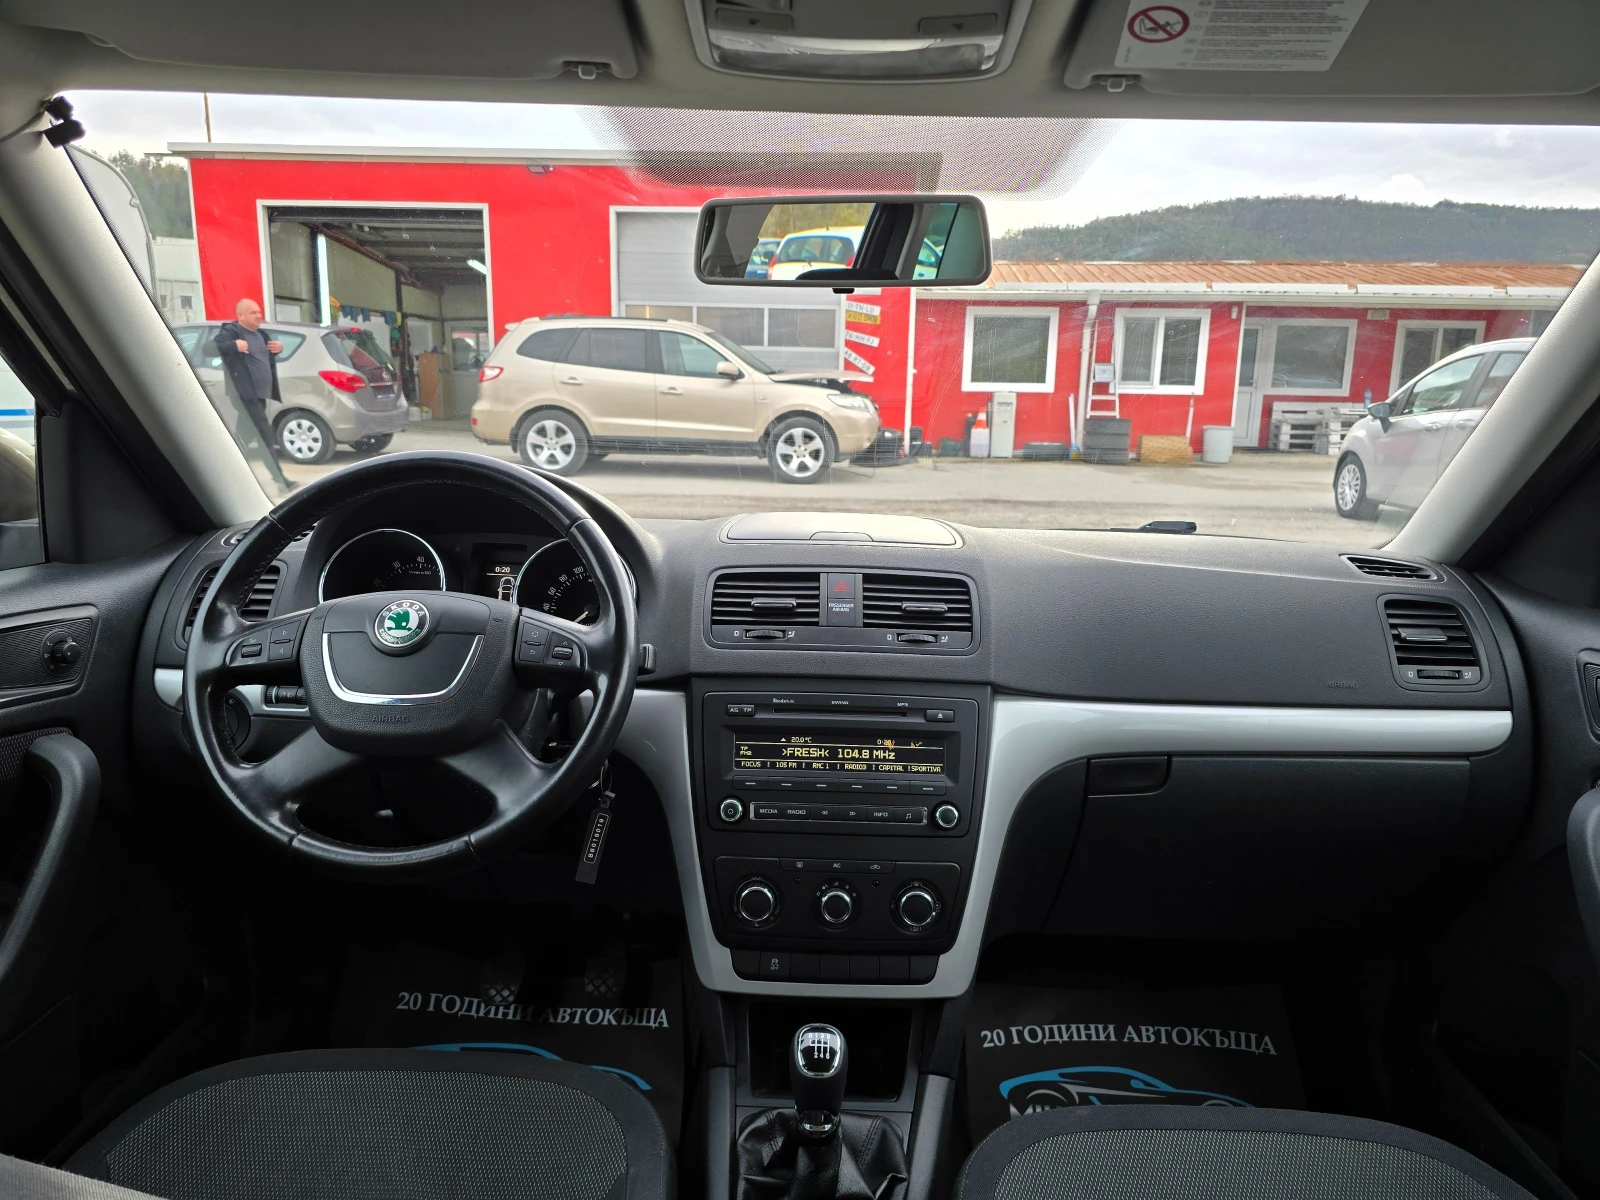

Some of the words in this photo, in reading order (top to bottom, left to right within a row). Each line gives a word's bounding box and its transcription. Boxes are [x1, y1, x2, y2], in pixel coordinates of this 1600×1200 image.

[837, 748, 870, 759] 104.8
[873, 750, 896, 759] MHz
[396, 992, 422, 1010] 20
[980, 1028, 1006, 1048] 20
[1010, 1024, 1118, 1045] ГОДИНИ
[1123, 1026, 1278, 1055] АВТОКЪЩА
